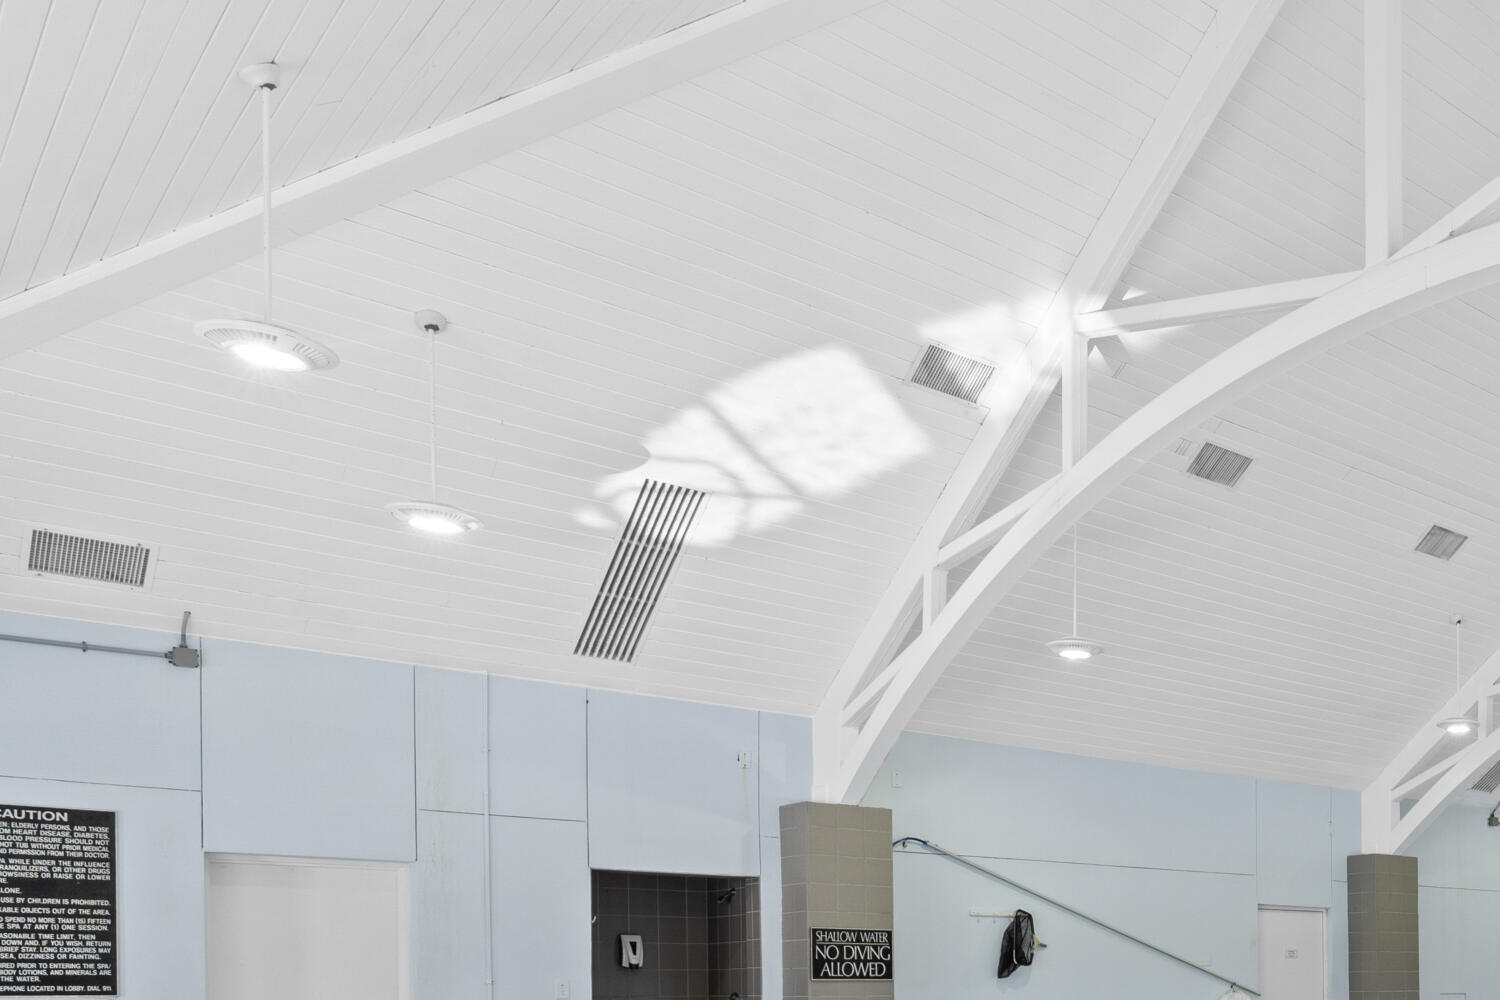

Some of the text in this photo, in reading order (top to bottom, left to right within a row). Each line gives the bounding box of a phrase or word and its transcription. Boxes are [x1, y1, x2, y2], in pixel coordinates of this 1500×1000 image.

[0, 809, 69, 822] AUTION
[11, 821, 39, 830] ELDERLY
[25, 835, 63, 844] PRESSURE
[30, 842, 61, 850] WITHOUT
[8, 848, 46, 856] PERMISSION
[8, 857, 31, 865] WHILE
[32, 858, 56, 866] UNDER
[73, 860, 110, 868] INFLUENCE
[0, 864, 50, 872] RANQUILIZERS,
[64, 866, 87, 874] OTHER
[87, 867, 111, 875] DRUGS
[0, 886, 23, 894] LONE.
[27, 897, 61, 905] CHILDREN
[0, 932, 36, 940] ASONABLE
[815, 930, 888, 943] SHALLOW WATER
[59, 946, 97, 954] EXPOSURES
[815, 944, 891, 960] NO DIVING
[0, 952, 17, 960] SEA,
[17, 952, 55, 960] DIZZINESS
[49, 962, 81, 970] ENTERING
[82, 962, 96, 970] THE
[820, 961, 886, 977] ALLOWED
